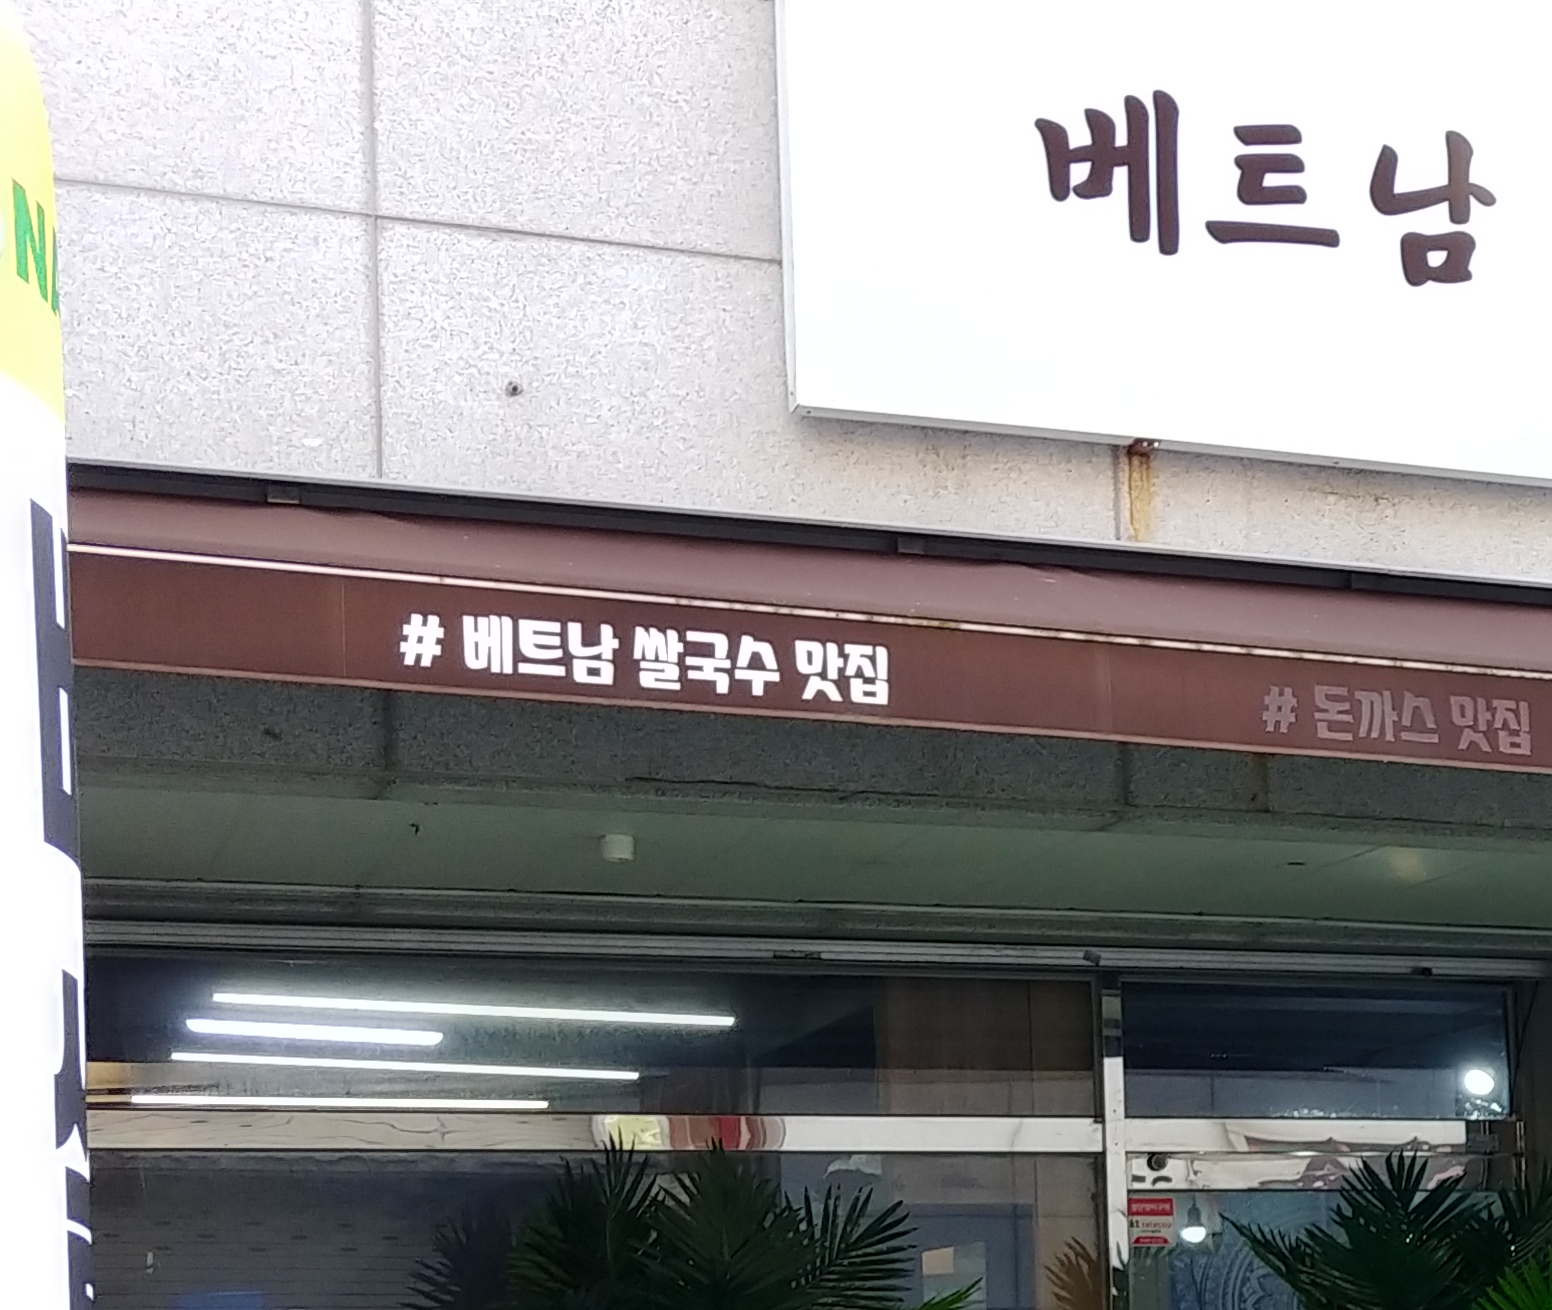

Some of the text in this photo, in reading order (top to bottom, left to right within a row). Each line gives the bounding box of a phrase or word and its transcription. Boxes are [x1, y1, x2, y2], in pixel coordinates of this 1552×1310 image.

[1033, 89, 1497, 286] 베트남
[463, 615, 619, 686] 베트남
[634, 626, 780, 696] 쌀국수
[796, 639, 889, 705] 맛집
[1313, 685, 1440, 744] 돈까스
[1451, 695, 1532, 756] 맛집
